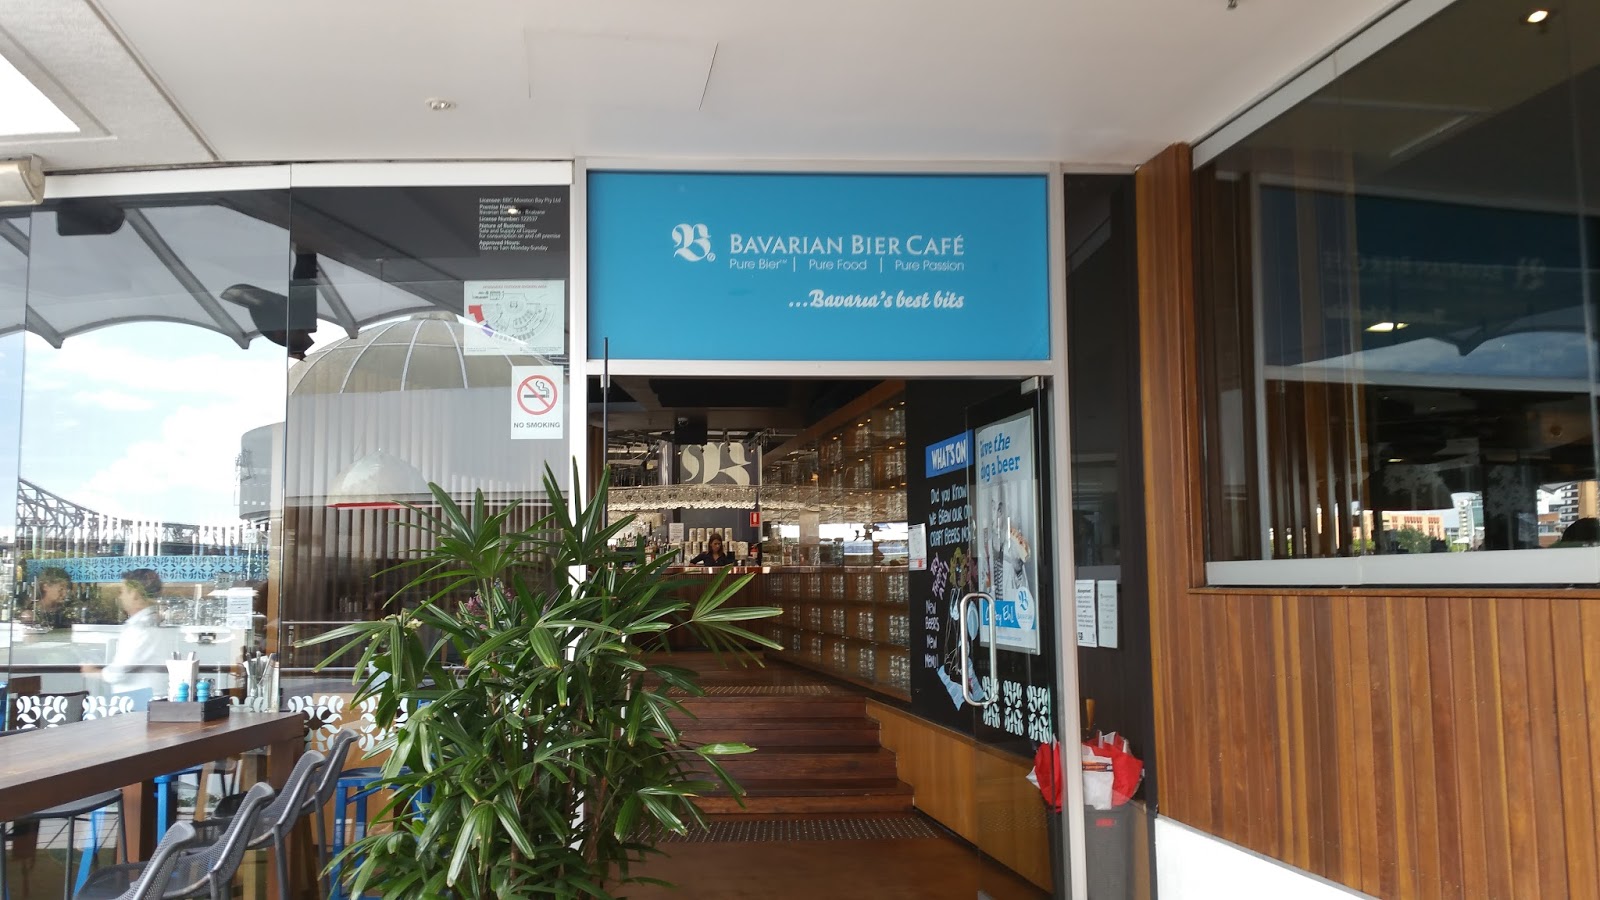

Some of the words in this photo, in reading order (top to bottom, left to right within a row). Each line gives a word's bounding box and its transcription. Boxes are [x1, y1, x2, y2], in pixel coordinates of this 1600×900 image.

[730, 234, 843, 255] BAVARIAN
[851, 235, 902, 255] BIER
[906, 234, 965, 256] CAFÉ
[729, 258, 756, 270] Pure
[809, 259, 834, 271] Pure
[837, 259, 868, 271] Food
[895, 259, 920, 272] Pure
[923, 259, 965, 272] Passion
[896, 289, 932, 309] best
[933, 289, 965, 309] bits
[955, 439, 967, 465] ON
[994, 432, 1011, 452] the
[991, 462, 996, 476] a
[997, 455, 1020, 475] beer
